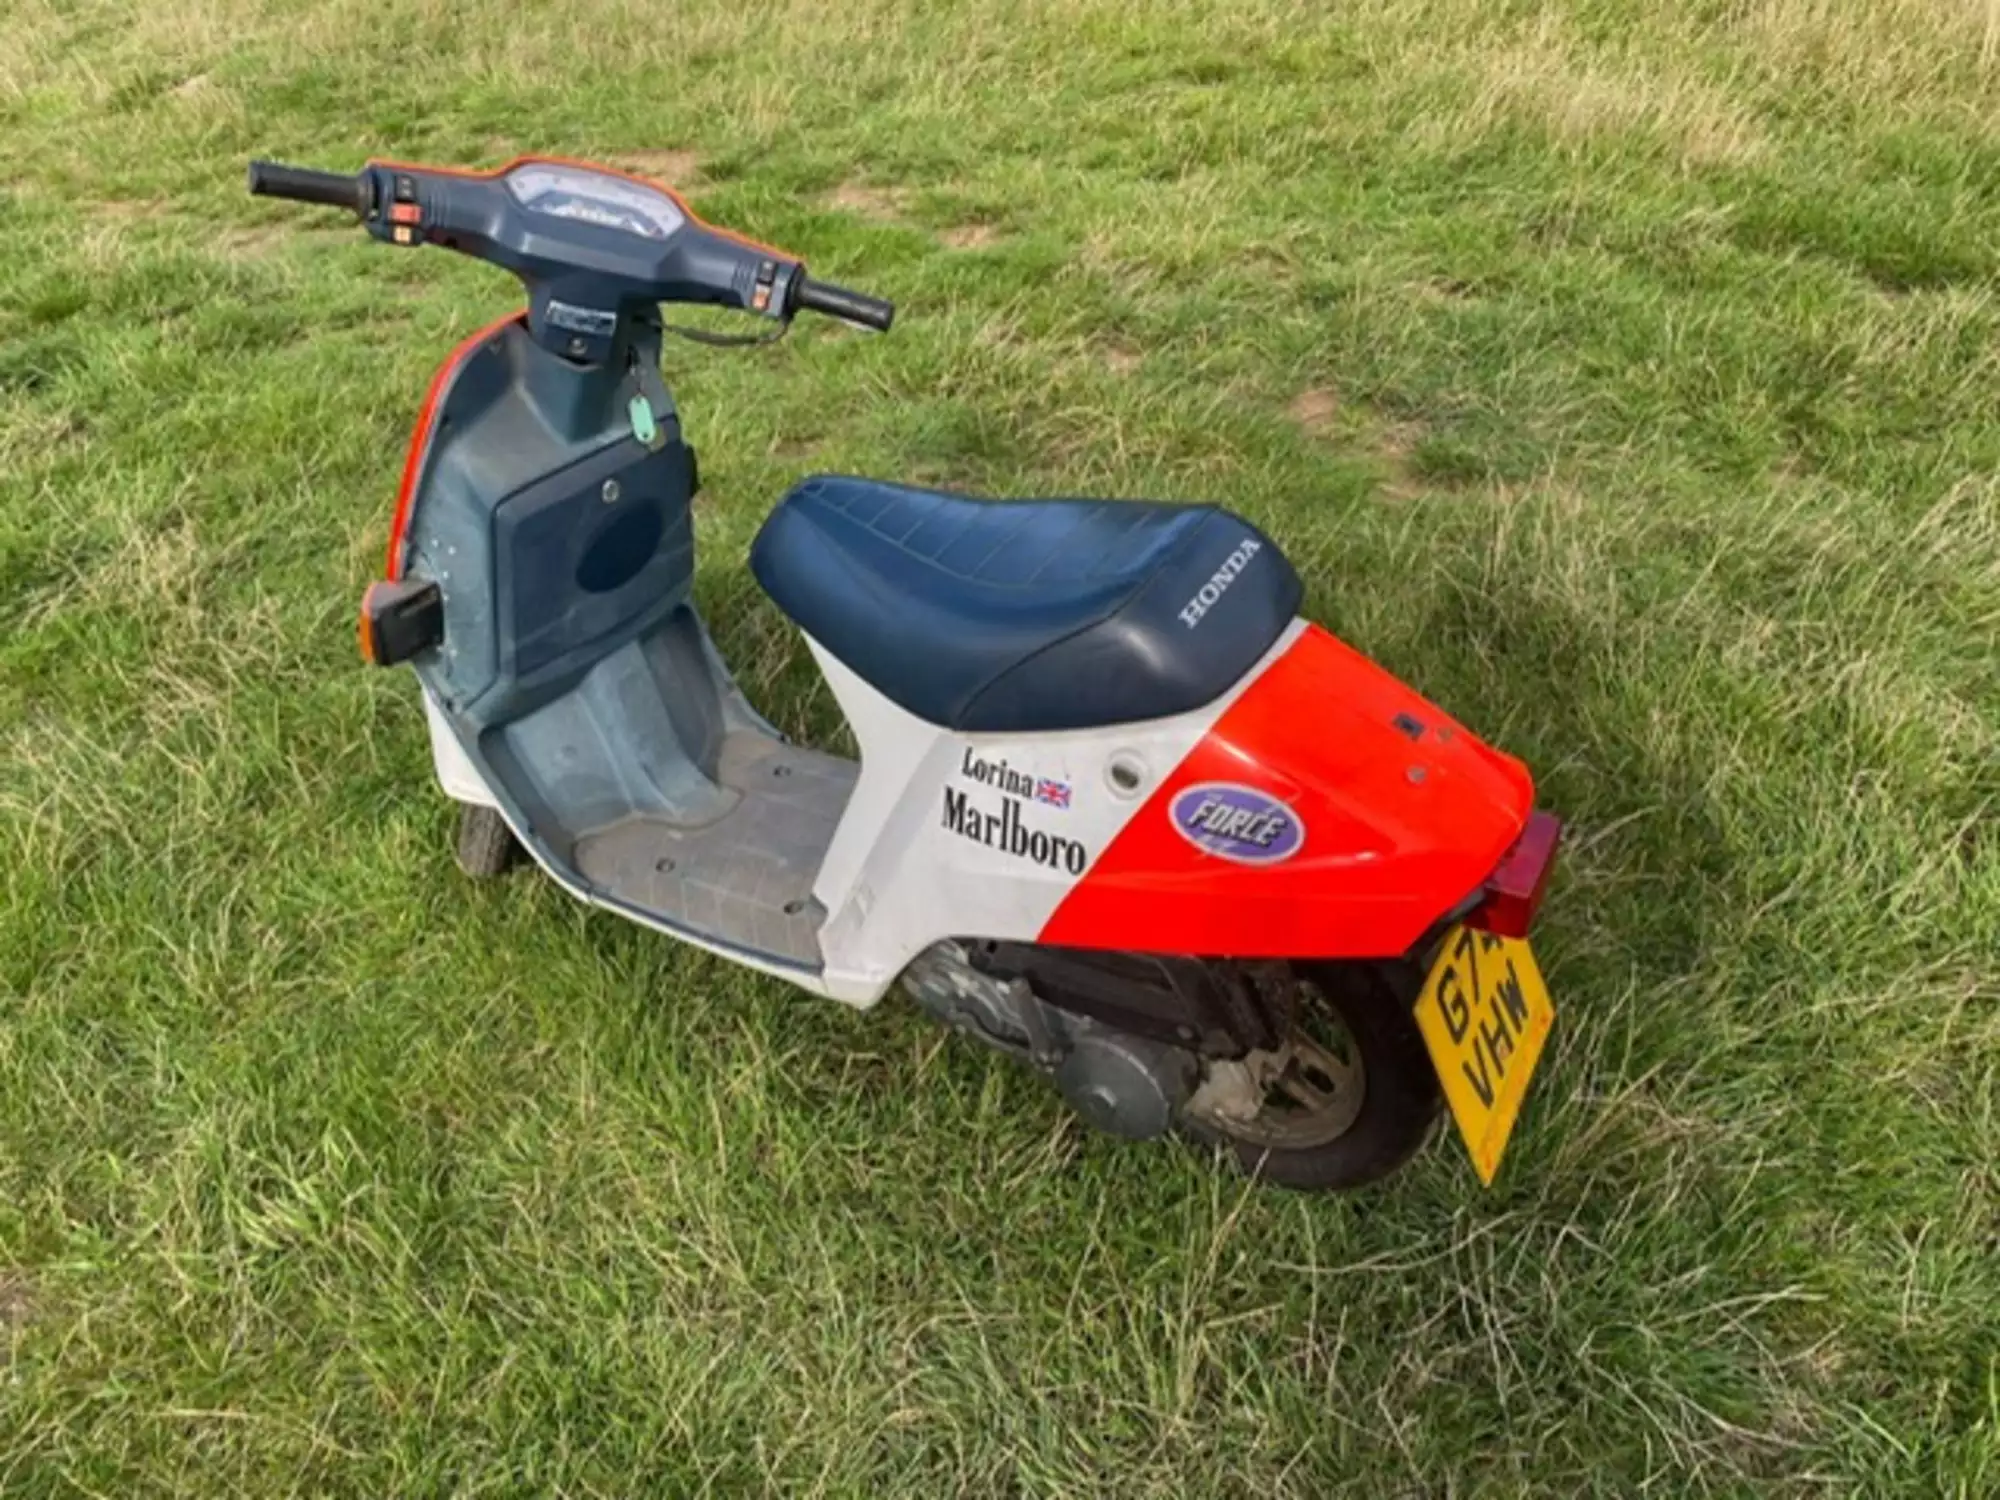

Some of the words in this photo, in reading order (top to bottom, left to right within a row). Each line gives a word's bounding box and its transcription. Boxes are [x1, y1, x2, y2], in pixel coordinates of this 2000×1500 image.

[1177, 538, 1262, 629] HONDA
[962, 746, 1034, 799] Lorina
[940, 785, 1087, 876] Marlboro
[1186, 799, 1286, 848] FORCE
[1462, 957, 1529, 1110] VHW
